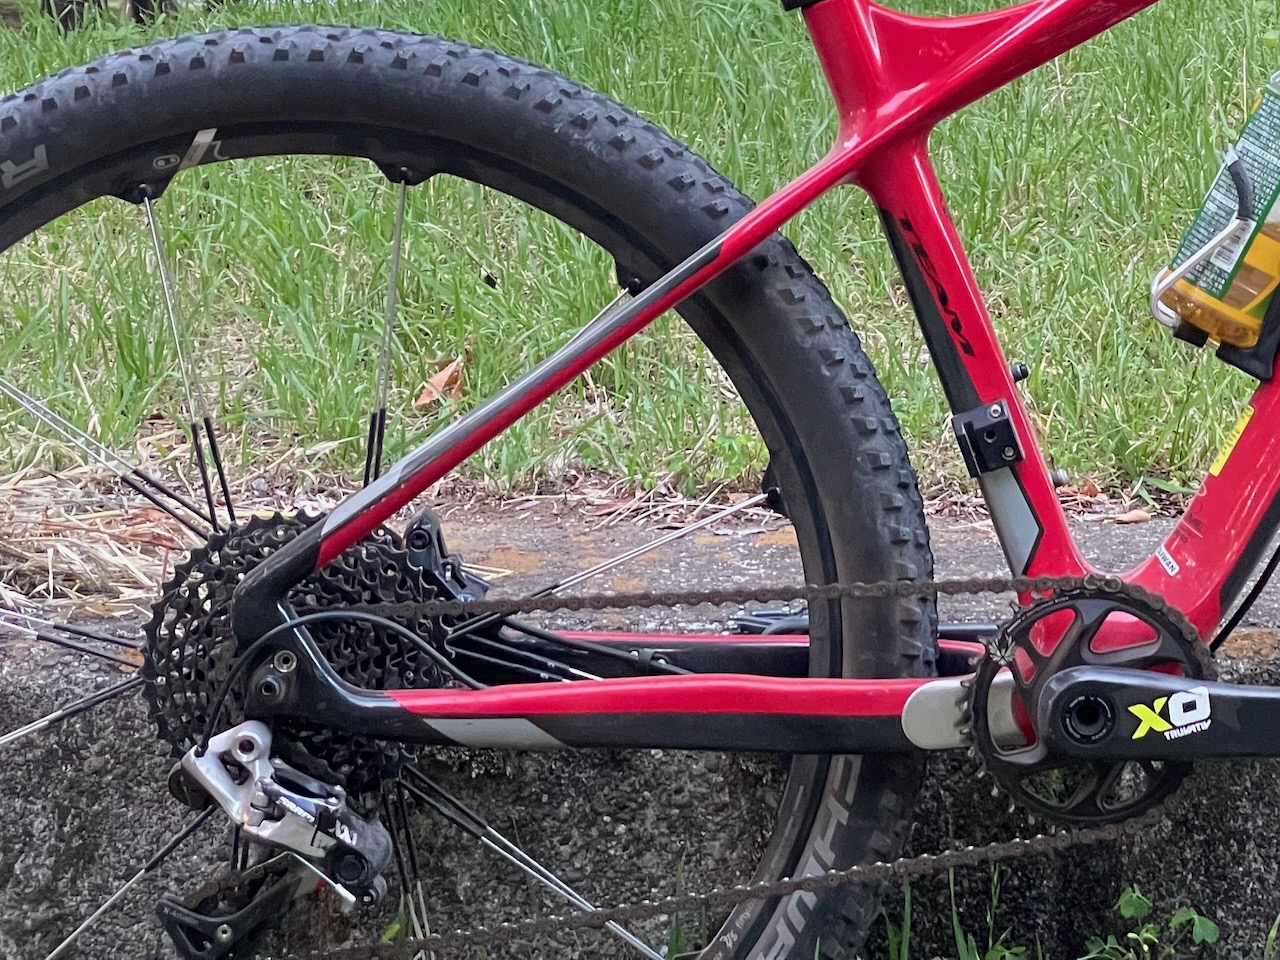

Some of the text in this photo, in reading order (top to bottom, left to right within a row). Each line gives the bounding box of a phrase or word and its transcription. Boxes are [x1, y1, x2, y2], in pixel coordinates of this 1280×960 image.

[899, 211, 975, 357] TEAM
[1163, 719, 1211, 741] TRUVATIV
[275, 796, 316, 824] SRAM
